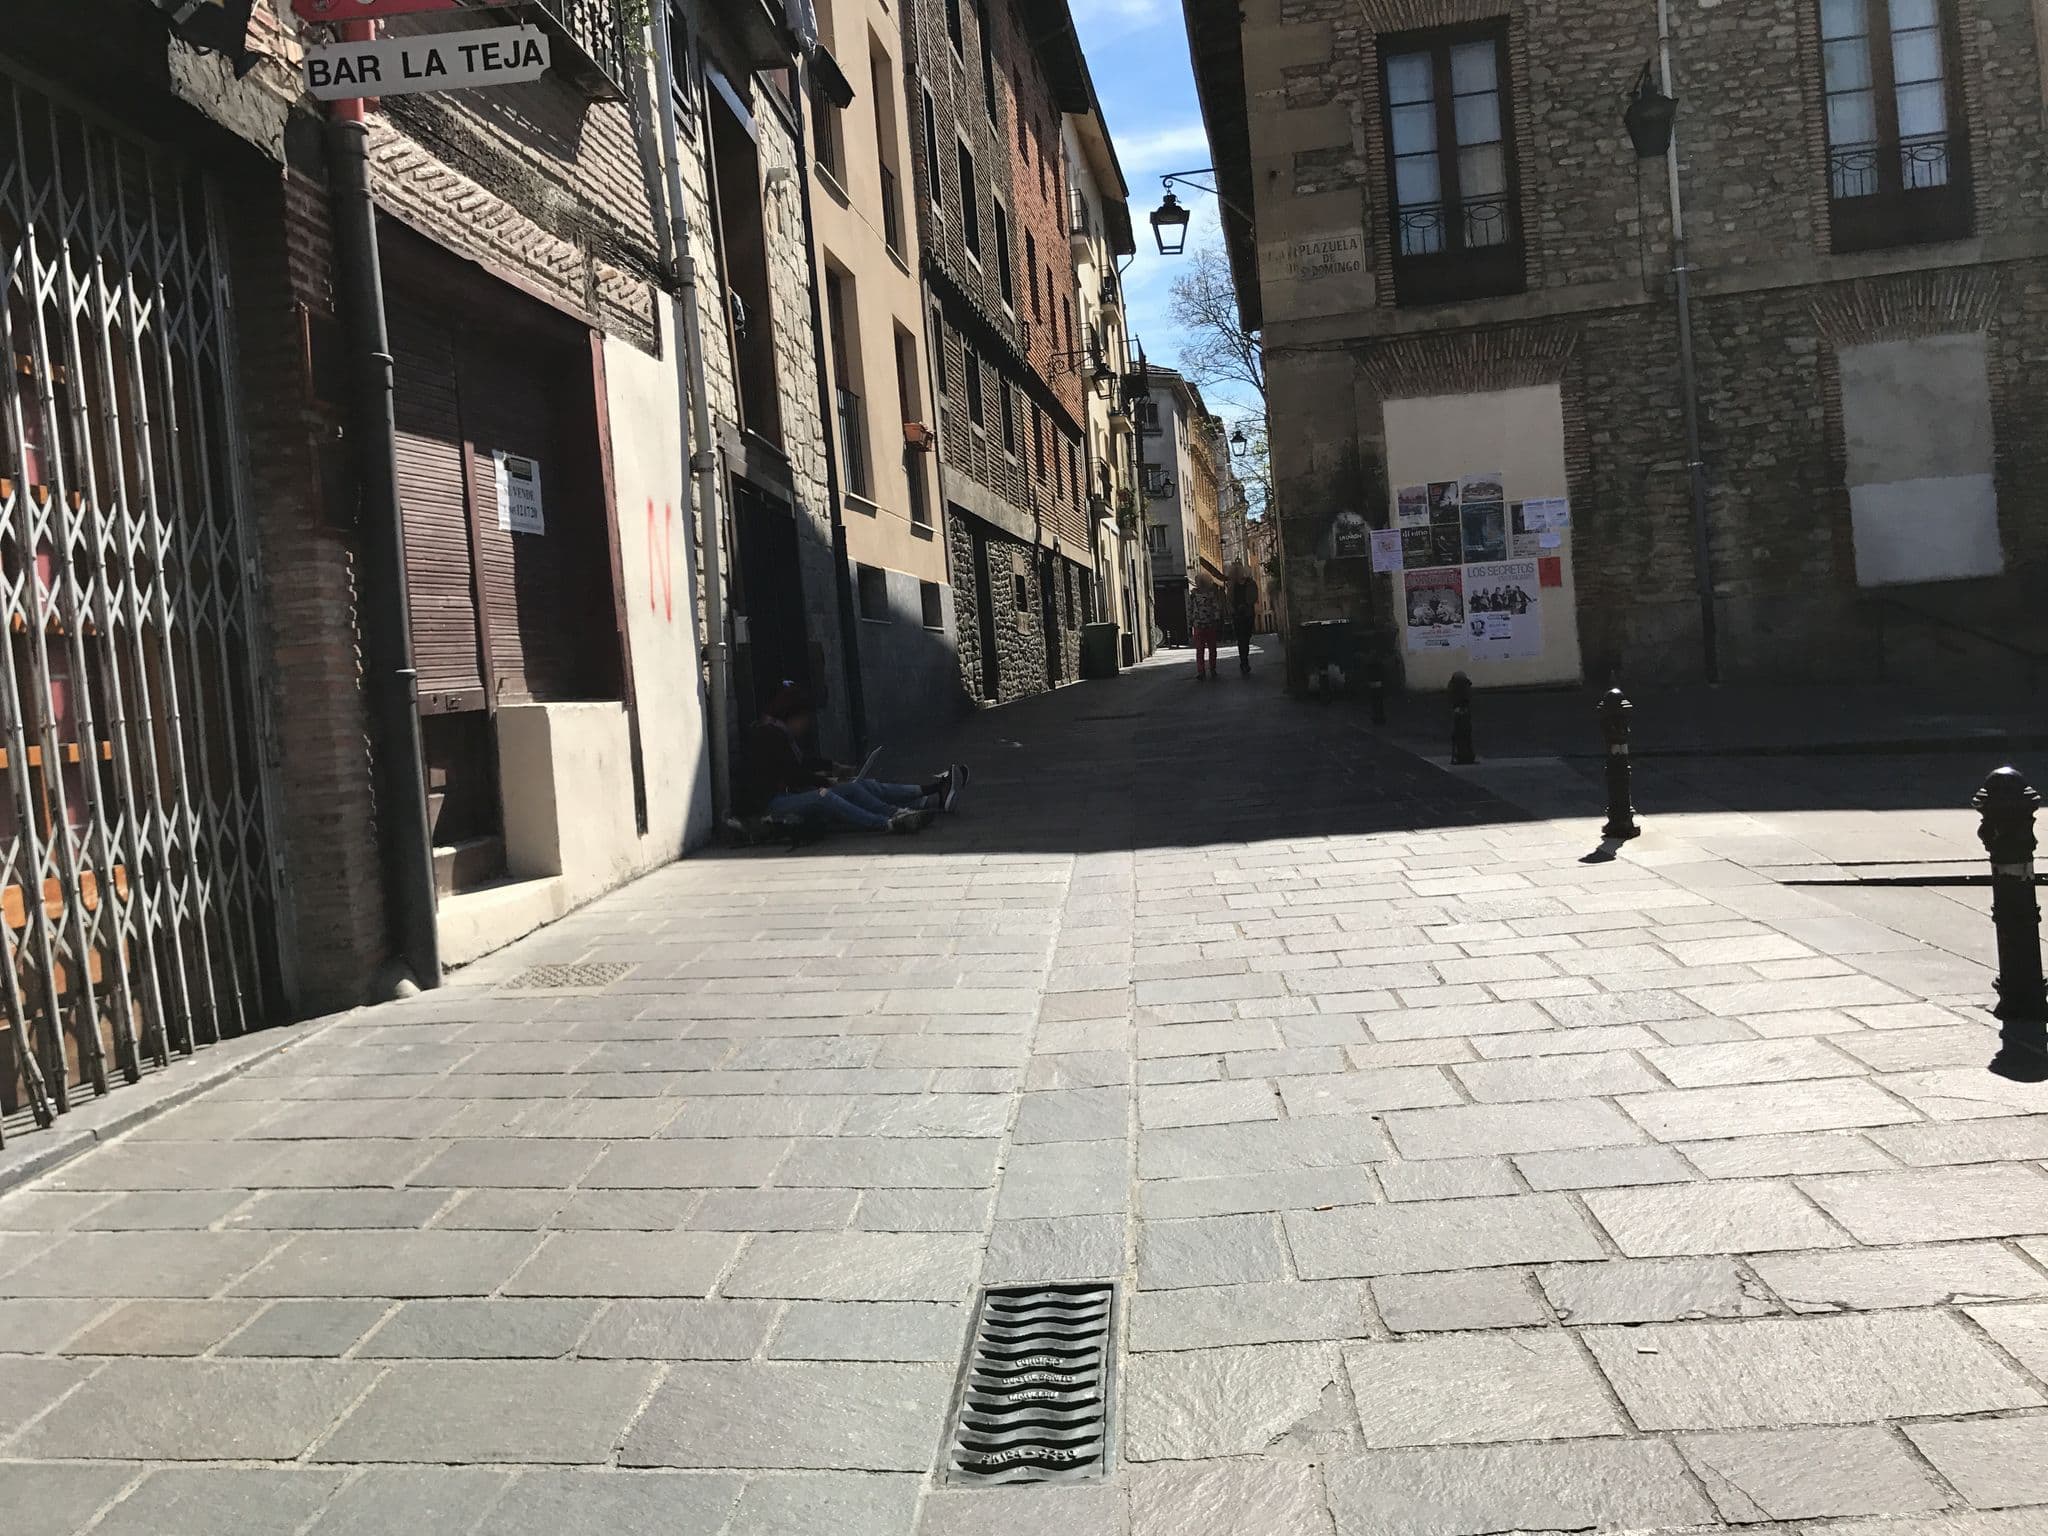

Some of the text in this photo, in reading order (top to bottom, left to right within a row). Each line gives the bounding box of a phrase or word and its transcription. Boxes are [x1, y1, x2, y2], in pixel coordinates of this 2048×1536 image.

[308, 39, 544, 88] BAR LA TEJA
[1298, 238, 1358, 256] PLAZUELA
[1322, 253, 1336, 264] DE
[1467, 566, 1486, 578] LOS
[1487, 563, 1535, 577] SECRETOS
